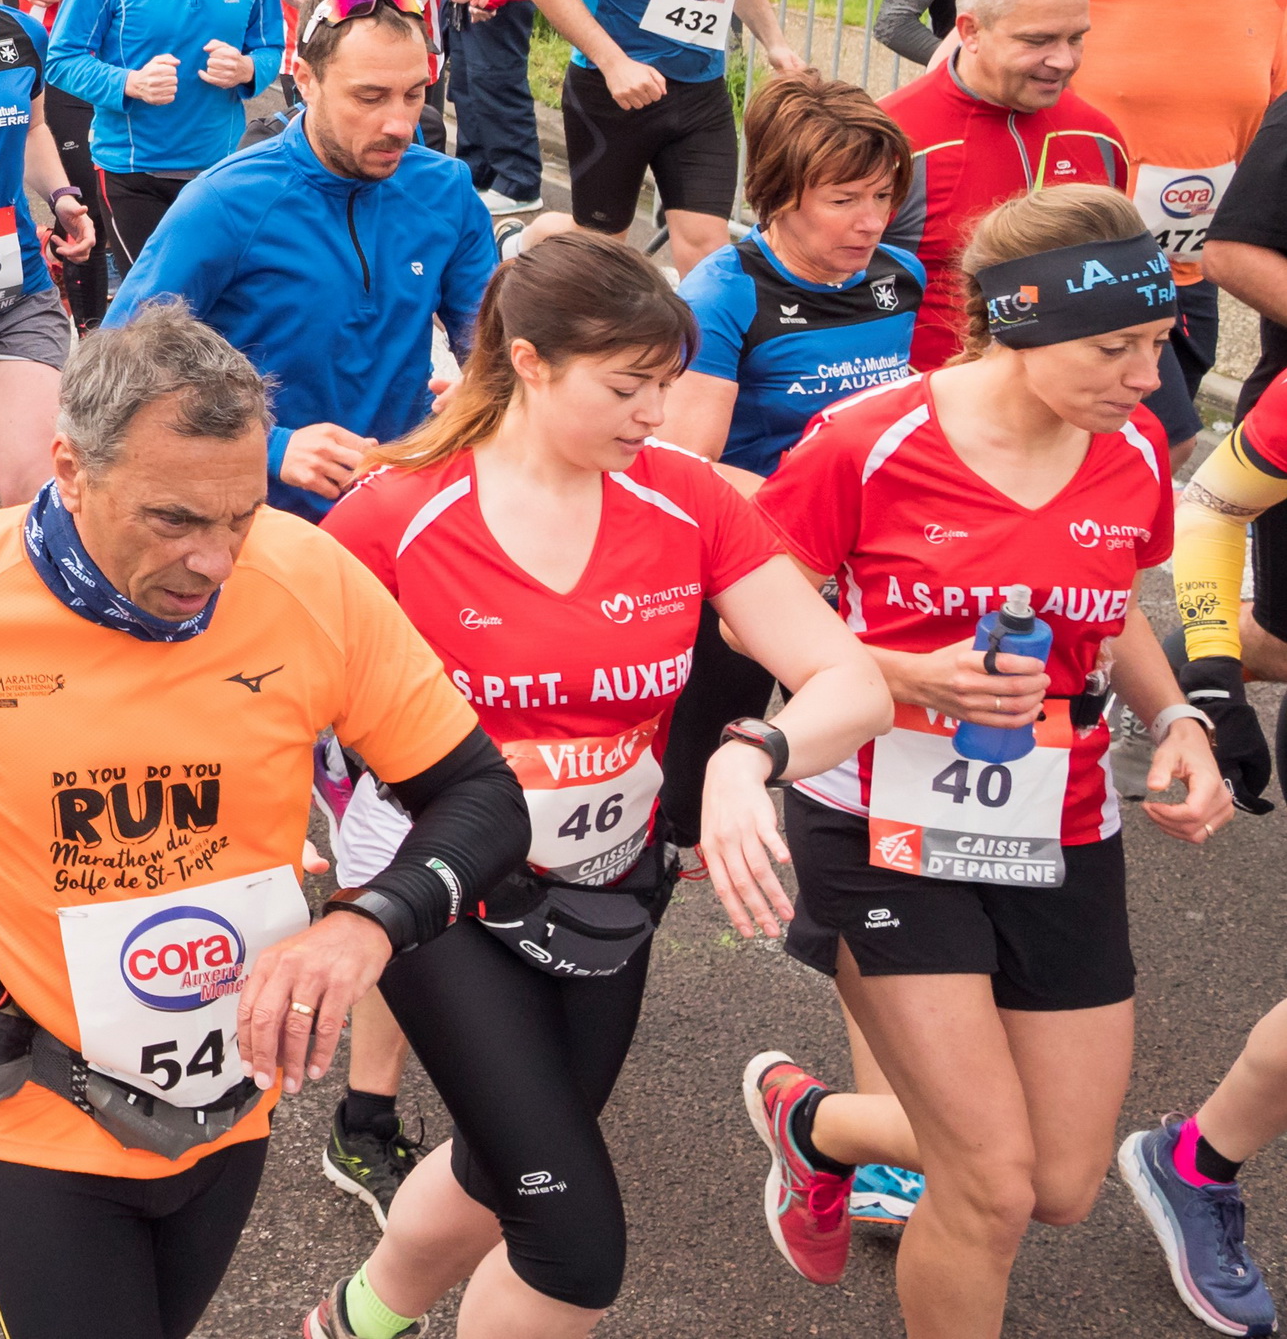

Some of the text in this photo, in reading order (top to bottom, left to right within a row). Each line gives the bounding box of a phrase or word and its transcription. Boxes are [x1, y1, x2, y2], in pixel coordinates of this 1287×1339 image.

[665, 6, 718, 35] 432
[1164, 189, 1210, 203] cora
[818, 353, 898, 379] Crédit Mutuel
[787, 382, 832, 395] A.J.
[537, 736, 628, 780] Vittel
[52, 763, 221, 788] DO YOU DO YOU
[932, 760, 1012, 807] 40
[52, 779, 220, 849] RUN
[557, 793, 624, 841] 46
[50, 828, 192, 869] Marathon du
[578, 838, 634, 876] CAISSE
[956, 836, 1030, 857] CAISSE
[54, 835, 230, 896] Golfe de St-Tropez
[927, 856, 1056, 883] D'EPARGNE
[865, 917, 900, 929] Kalenji
[128, 935, 233, 981] cora
[181, 963, 243, 989] Auxerre
[140, 1028, 223, 1091] 54
[518, 1180, 567, 1196] Kalenji
